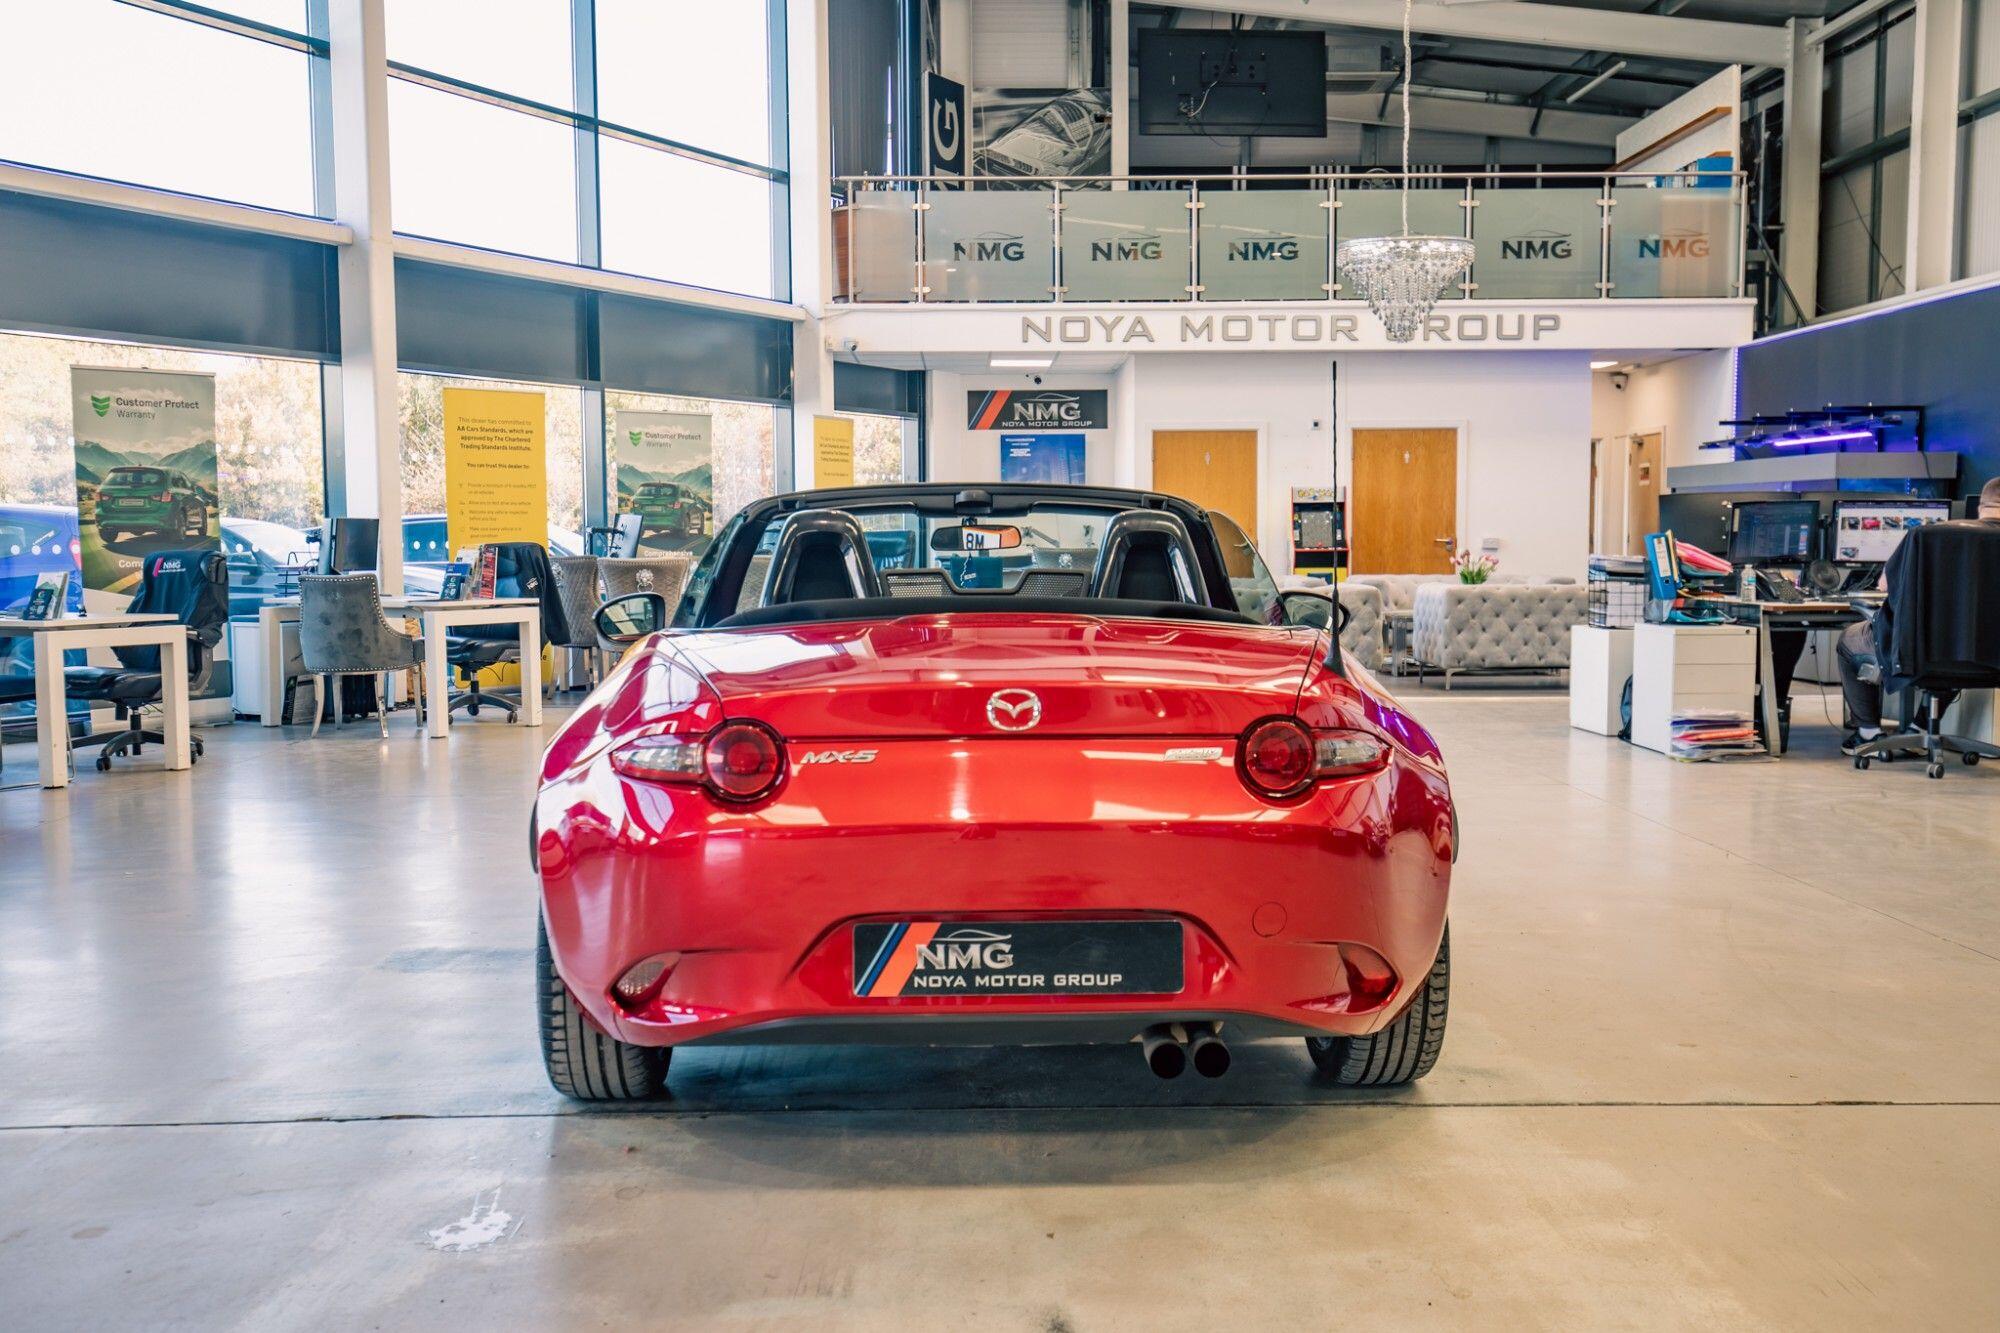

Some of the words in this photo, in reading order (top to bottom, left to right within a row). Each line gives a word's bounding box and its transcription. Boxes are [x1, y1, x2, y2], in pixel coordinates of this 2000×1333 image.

[953, 242, 1025, 262] NMG
[1091, 242, 1163, 262] NMG
[1228, 242, 1300, 262] NMG
[1501, 240, 1573, 259] NMG
[1638, 238, 1710, 258] NMG
[1021, 315, 1155, 343] NOYA
[1180, 314, 1360, 343] MOTOR
[1386, 313, 1562, 342] ROUP
[115, 397, 163, 408] Customer
[165, 399, 200, 410] Protect
[1012, 401, 1081, 421] NMG
[116, 409, 156, 420] Warranty
[645, 431, 676, 440] Customer
[677, 432, 702, 441] Protect
[163, 561, 182, 570] NMG
[914, 943, 1014, 970] NMG
[913, 974, 967, 988] NOYA
[975, 974, 1046, 988] MOTOR
[1053, 973, 1123, 987] GROUP
